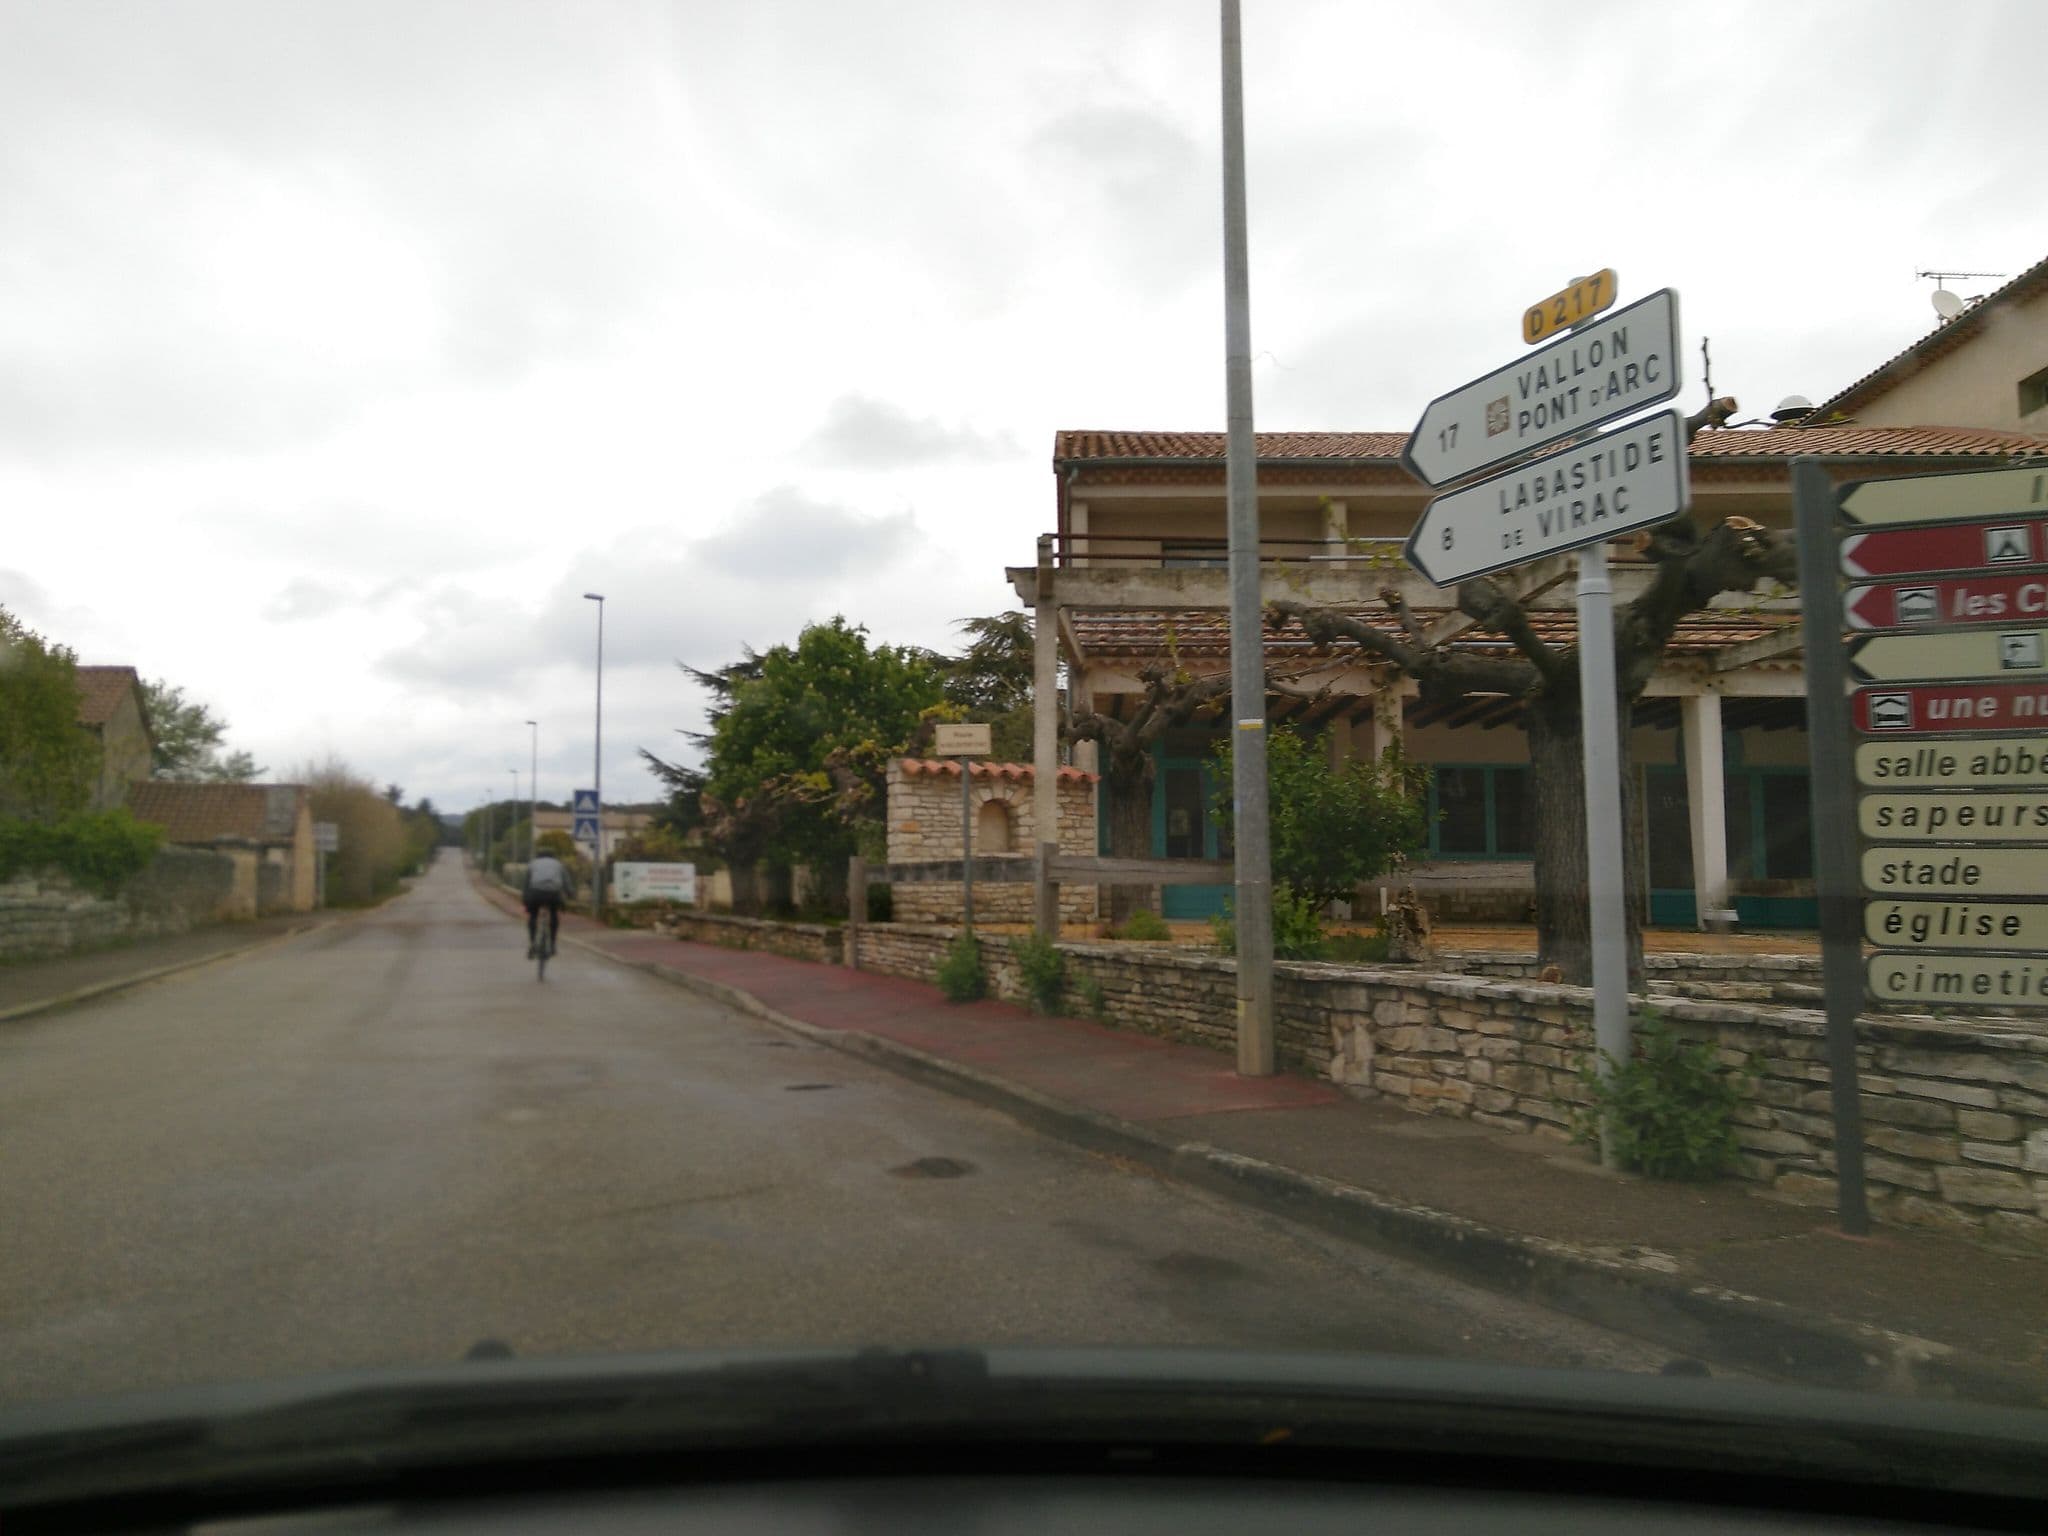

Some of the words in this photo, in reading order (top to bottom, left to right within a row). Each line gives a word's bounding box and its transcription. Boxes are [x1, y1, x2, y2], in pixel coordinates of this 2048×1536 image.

[1530, 309, 1544, 335] D
[1554, 278, 1603, 325] 217
[1517, 326, 1629, 400] VALLON
[1519, 387, 1581, 438] PONT
[1438, 423, 1459, 453] 17
[1500, 432, 1664, 515] LABASTIDE
[1502, 527, 1524, 550] DE
[1537, 486, 1630, 538] VIRAC
[1441, 527, 1454, 551] 8
[1952, 589, 2007, 616] les
[2016, 583, 2048, 613] C
[1927, 696, 1999, 720] une
[1874, 749, 1957, 778] salle
[1876, 804, 2048, 834] sapeurs
[1880, 857, 1982, 886] stade
[1885, 906, 2022, 942] église
